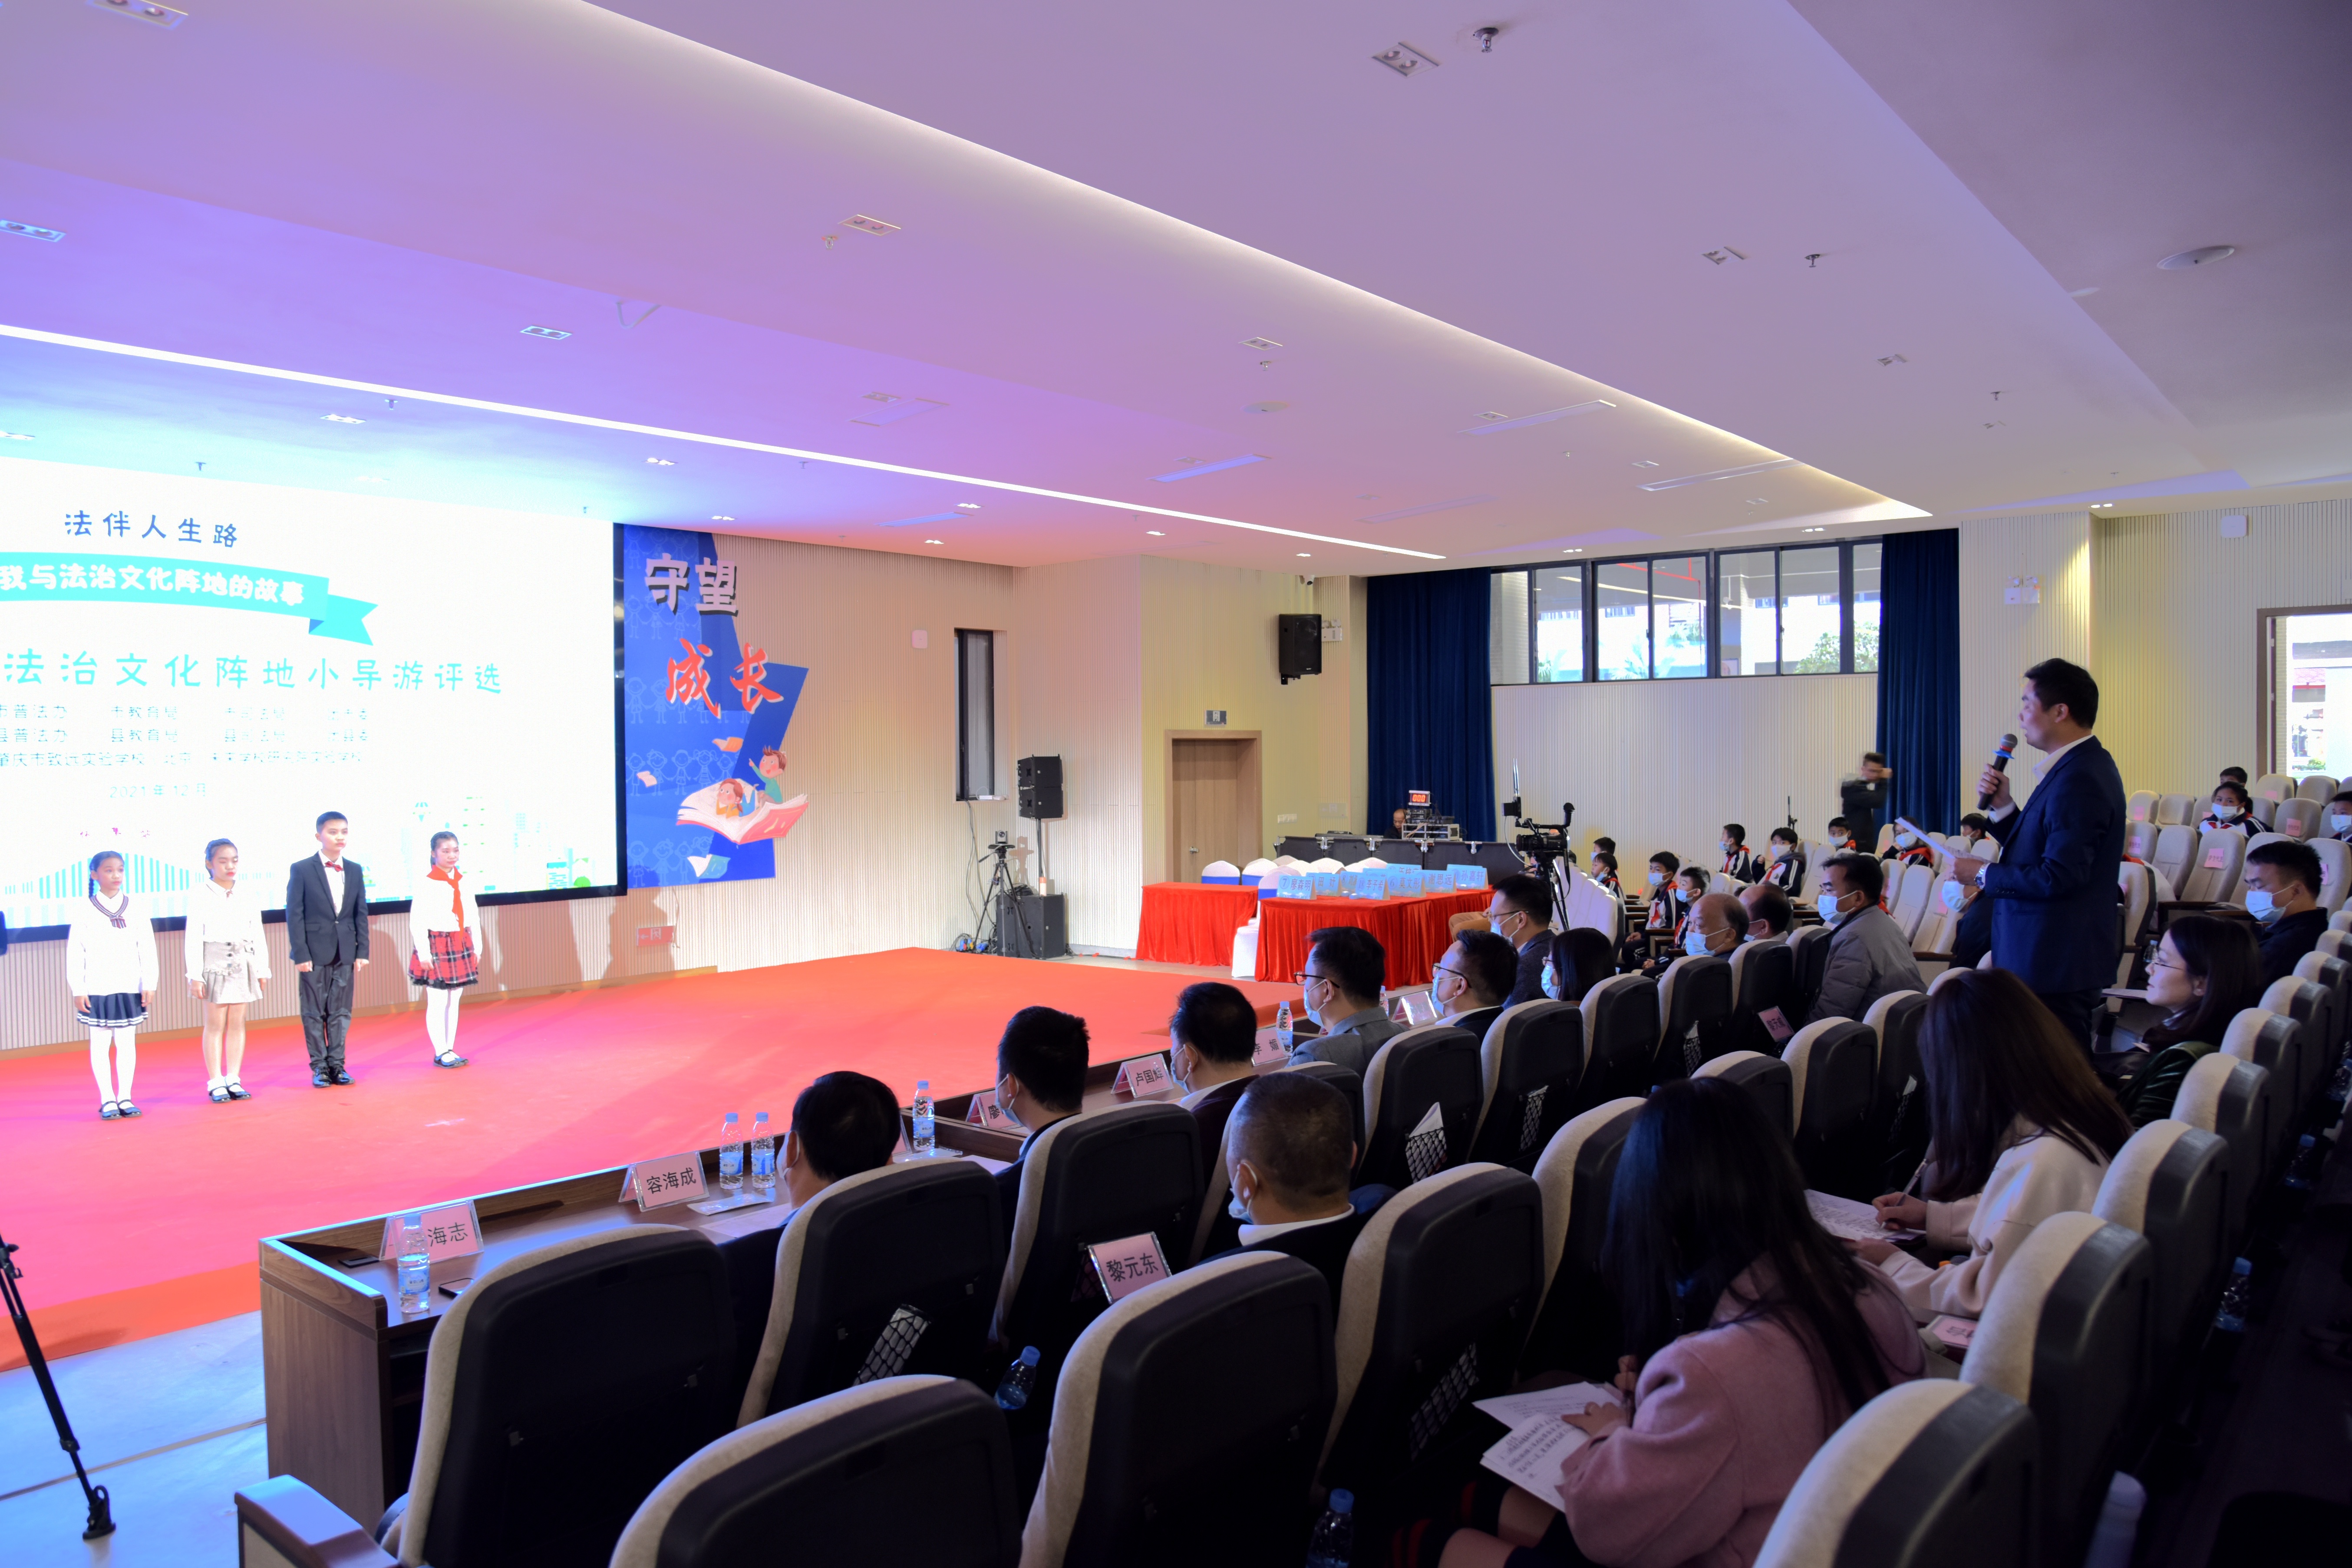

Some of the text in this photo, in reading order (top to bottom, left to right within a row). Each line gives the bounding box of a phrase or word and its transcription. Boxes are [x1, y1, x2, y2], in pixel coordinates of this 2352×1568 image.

[65, 510, 238, 548] 法伴人生路
[0, 563, 305, 606] 我与法治文化阵地的故事
[645, 553, 737, 615] 守望
[4, 648, 502, 695] 法治文化阵地小导游评选
[666, 639, 783, 719] 成长
[111, 705, 178, 720] 市教育局
[111, 729, 178, 743] 县教育局
[110, 783, 207, 799] 2021年12月
[1412, 794, 1426, 802] 000
[1290, 878, 1311, 891] 廖森明
[1428, 873, 1452, 885] 谢思远
[1136, 1067, 1164, 1086] 卢国辉
[647, 1167, 696, 1194] 容海成
[1106, 1253, 1159, 1282] 黎元东
